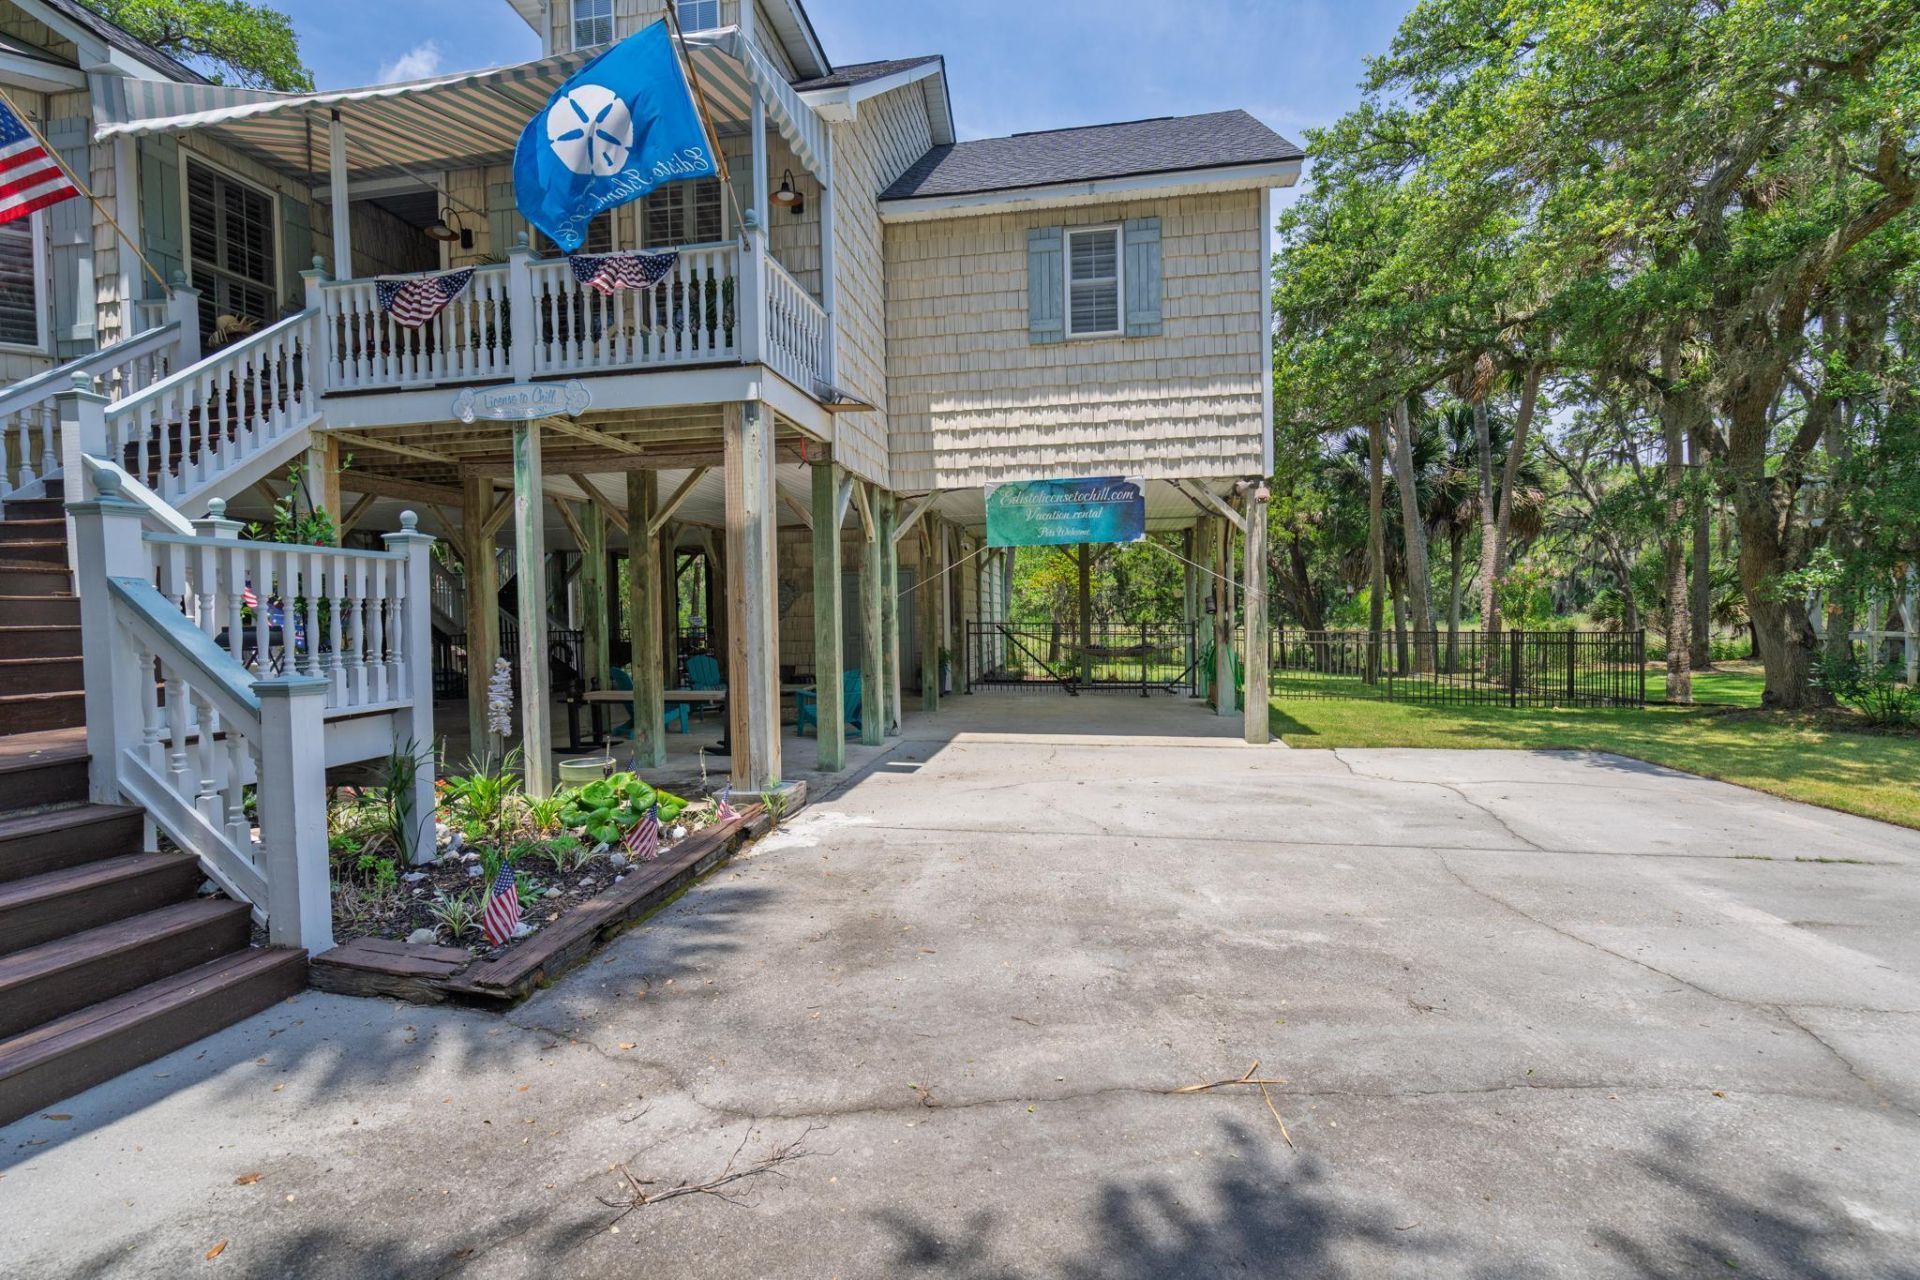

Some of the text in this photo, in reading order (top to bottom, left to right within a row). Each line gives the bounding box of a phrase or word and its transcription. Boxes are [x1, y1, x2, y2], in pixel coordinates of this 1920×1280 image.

[484, 386, 556, 408] License to Chill
[1000, 486, 1134, 505] Edistolicensetochill.com
[1025, 506, 1103, 522] Vacation rental
